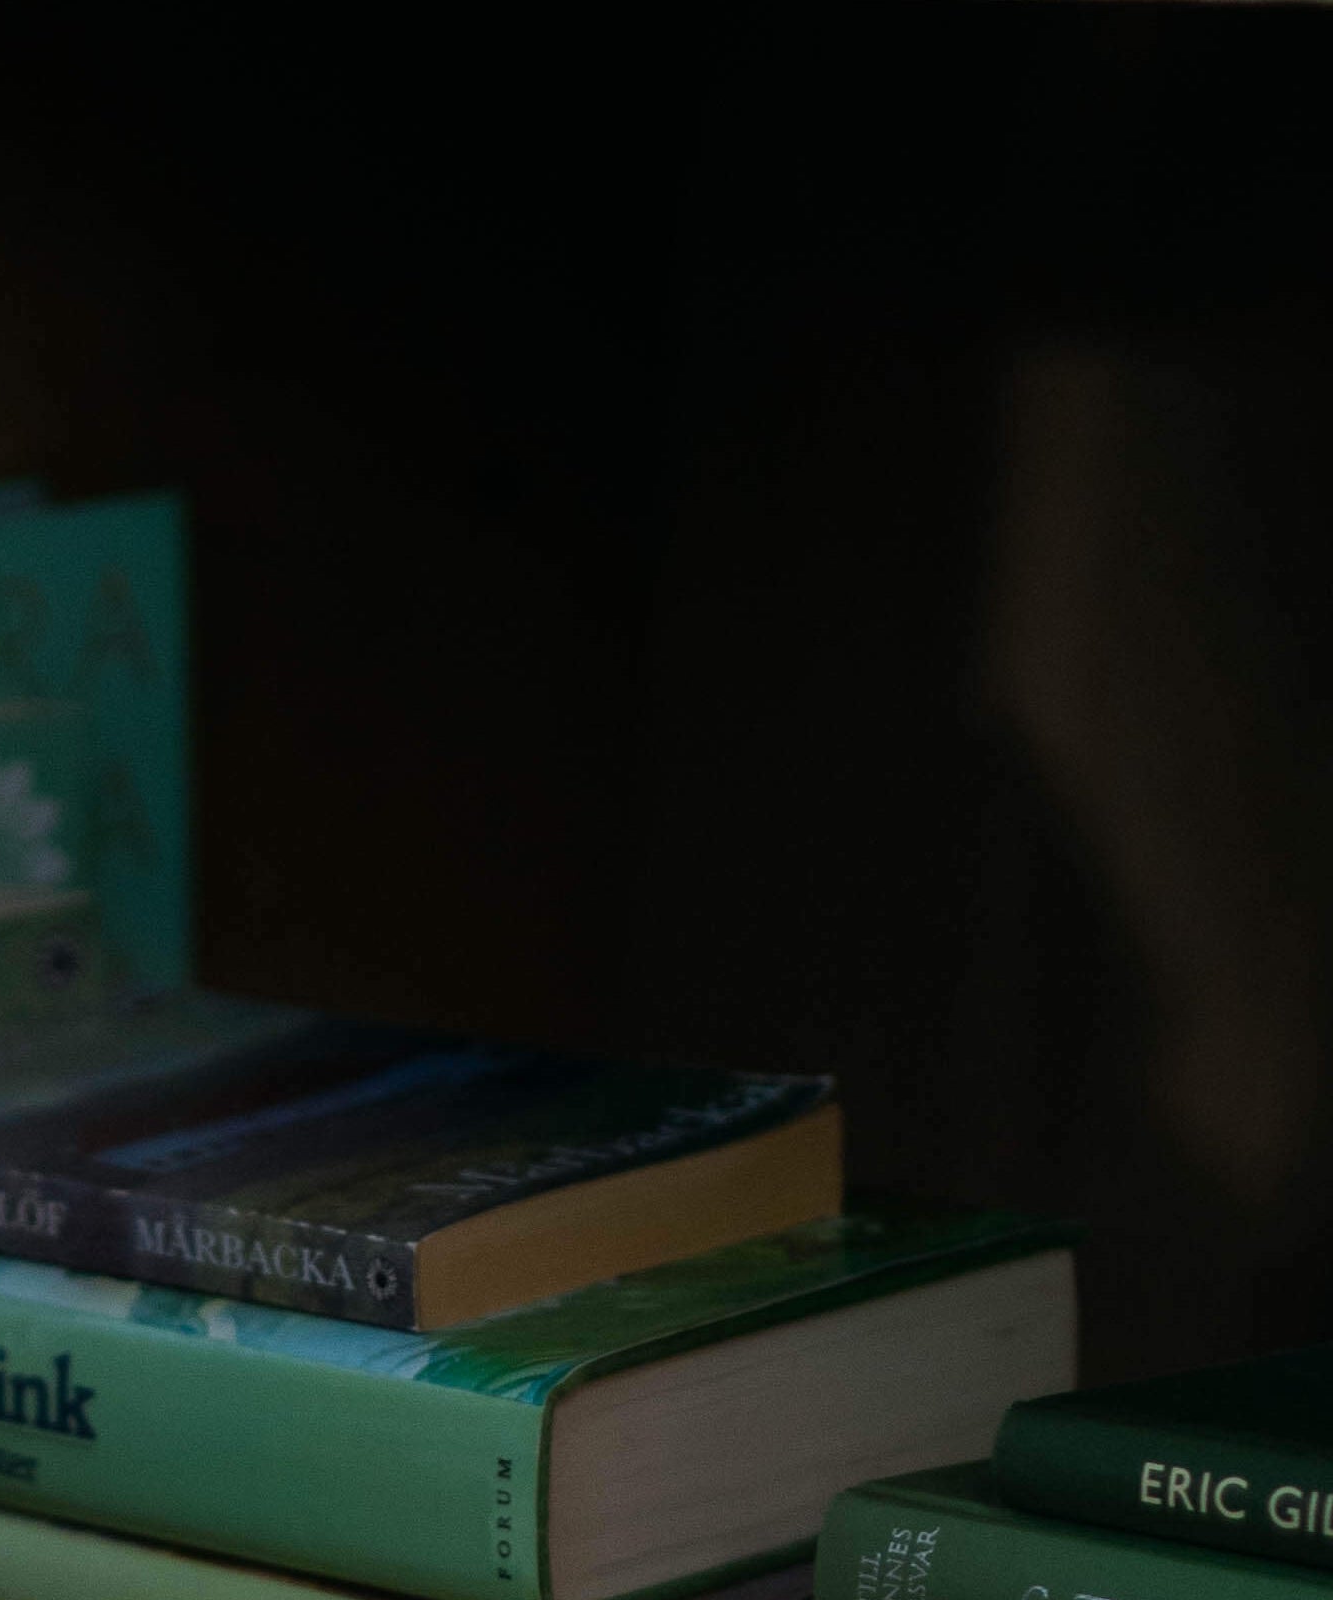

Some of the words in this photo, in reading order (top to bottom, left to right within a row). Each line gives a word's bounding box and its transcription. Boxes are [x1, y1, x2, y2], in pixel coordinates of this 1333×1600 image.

[134, 1214, 357, 1293] MÅRBACKA
[497, 1454, 513, 1582] FORUM
[1139, 1460, 1250, 1520] ERIC
